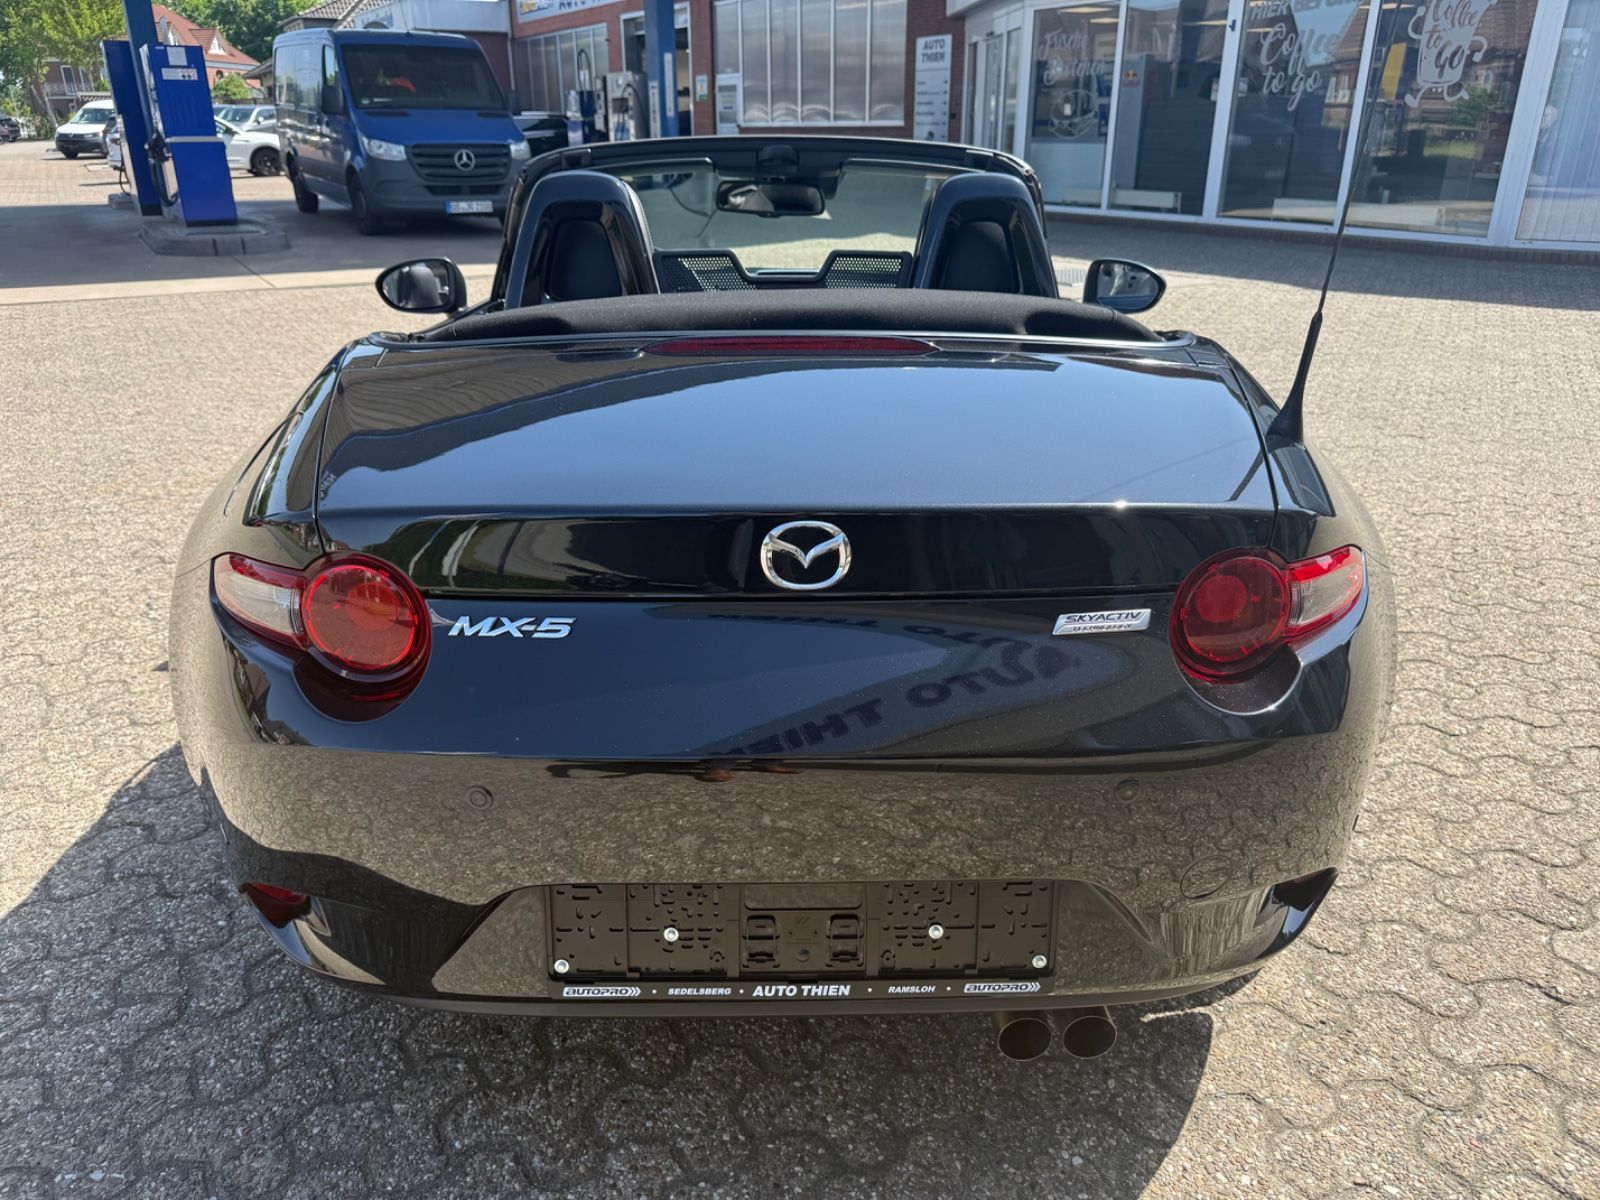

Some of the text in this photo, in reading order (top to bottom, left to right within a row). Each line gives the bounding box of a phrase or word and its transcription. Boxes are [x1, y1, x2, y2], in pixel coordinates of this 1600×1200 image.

[923, 39, 945, 51] AUTO
[1260, 23, 1340, 75] Coffee
[921, 52, 946, 64] THIEN
[1262, 66, 1320, 112] to go
[1064, 611, 1142, 624] SKYACTIV
[448, 615, 577, 639] MX-5
[668, 987, 732, 996] SEDELSBERG
[752, 985, 798, 997] AUTO
[801, 985, 851, 996] THIEN
[888, 985, 936, 993] RAMSLOH
